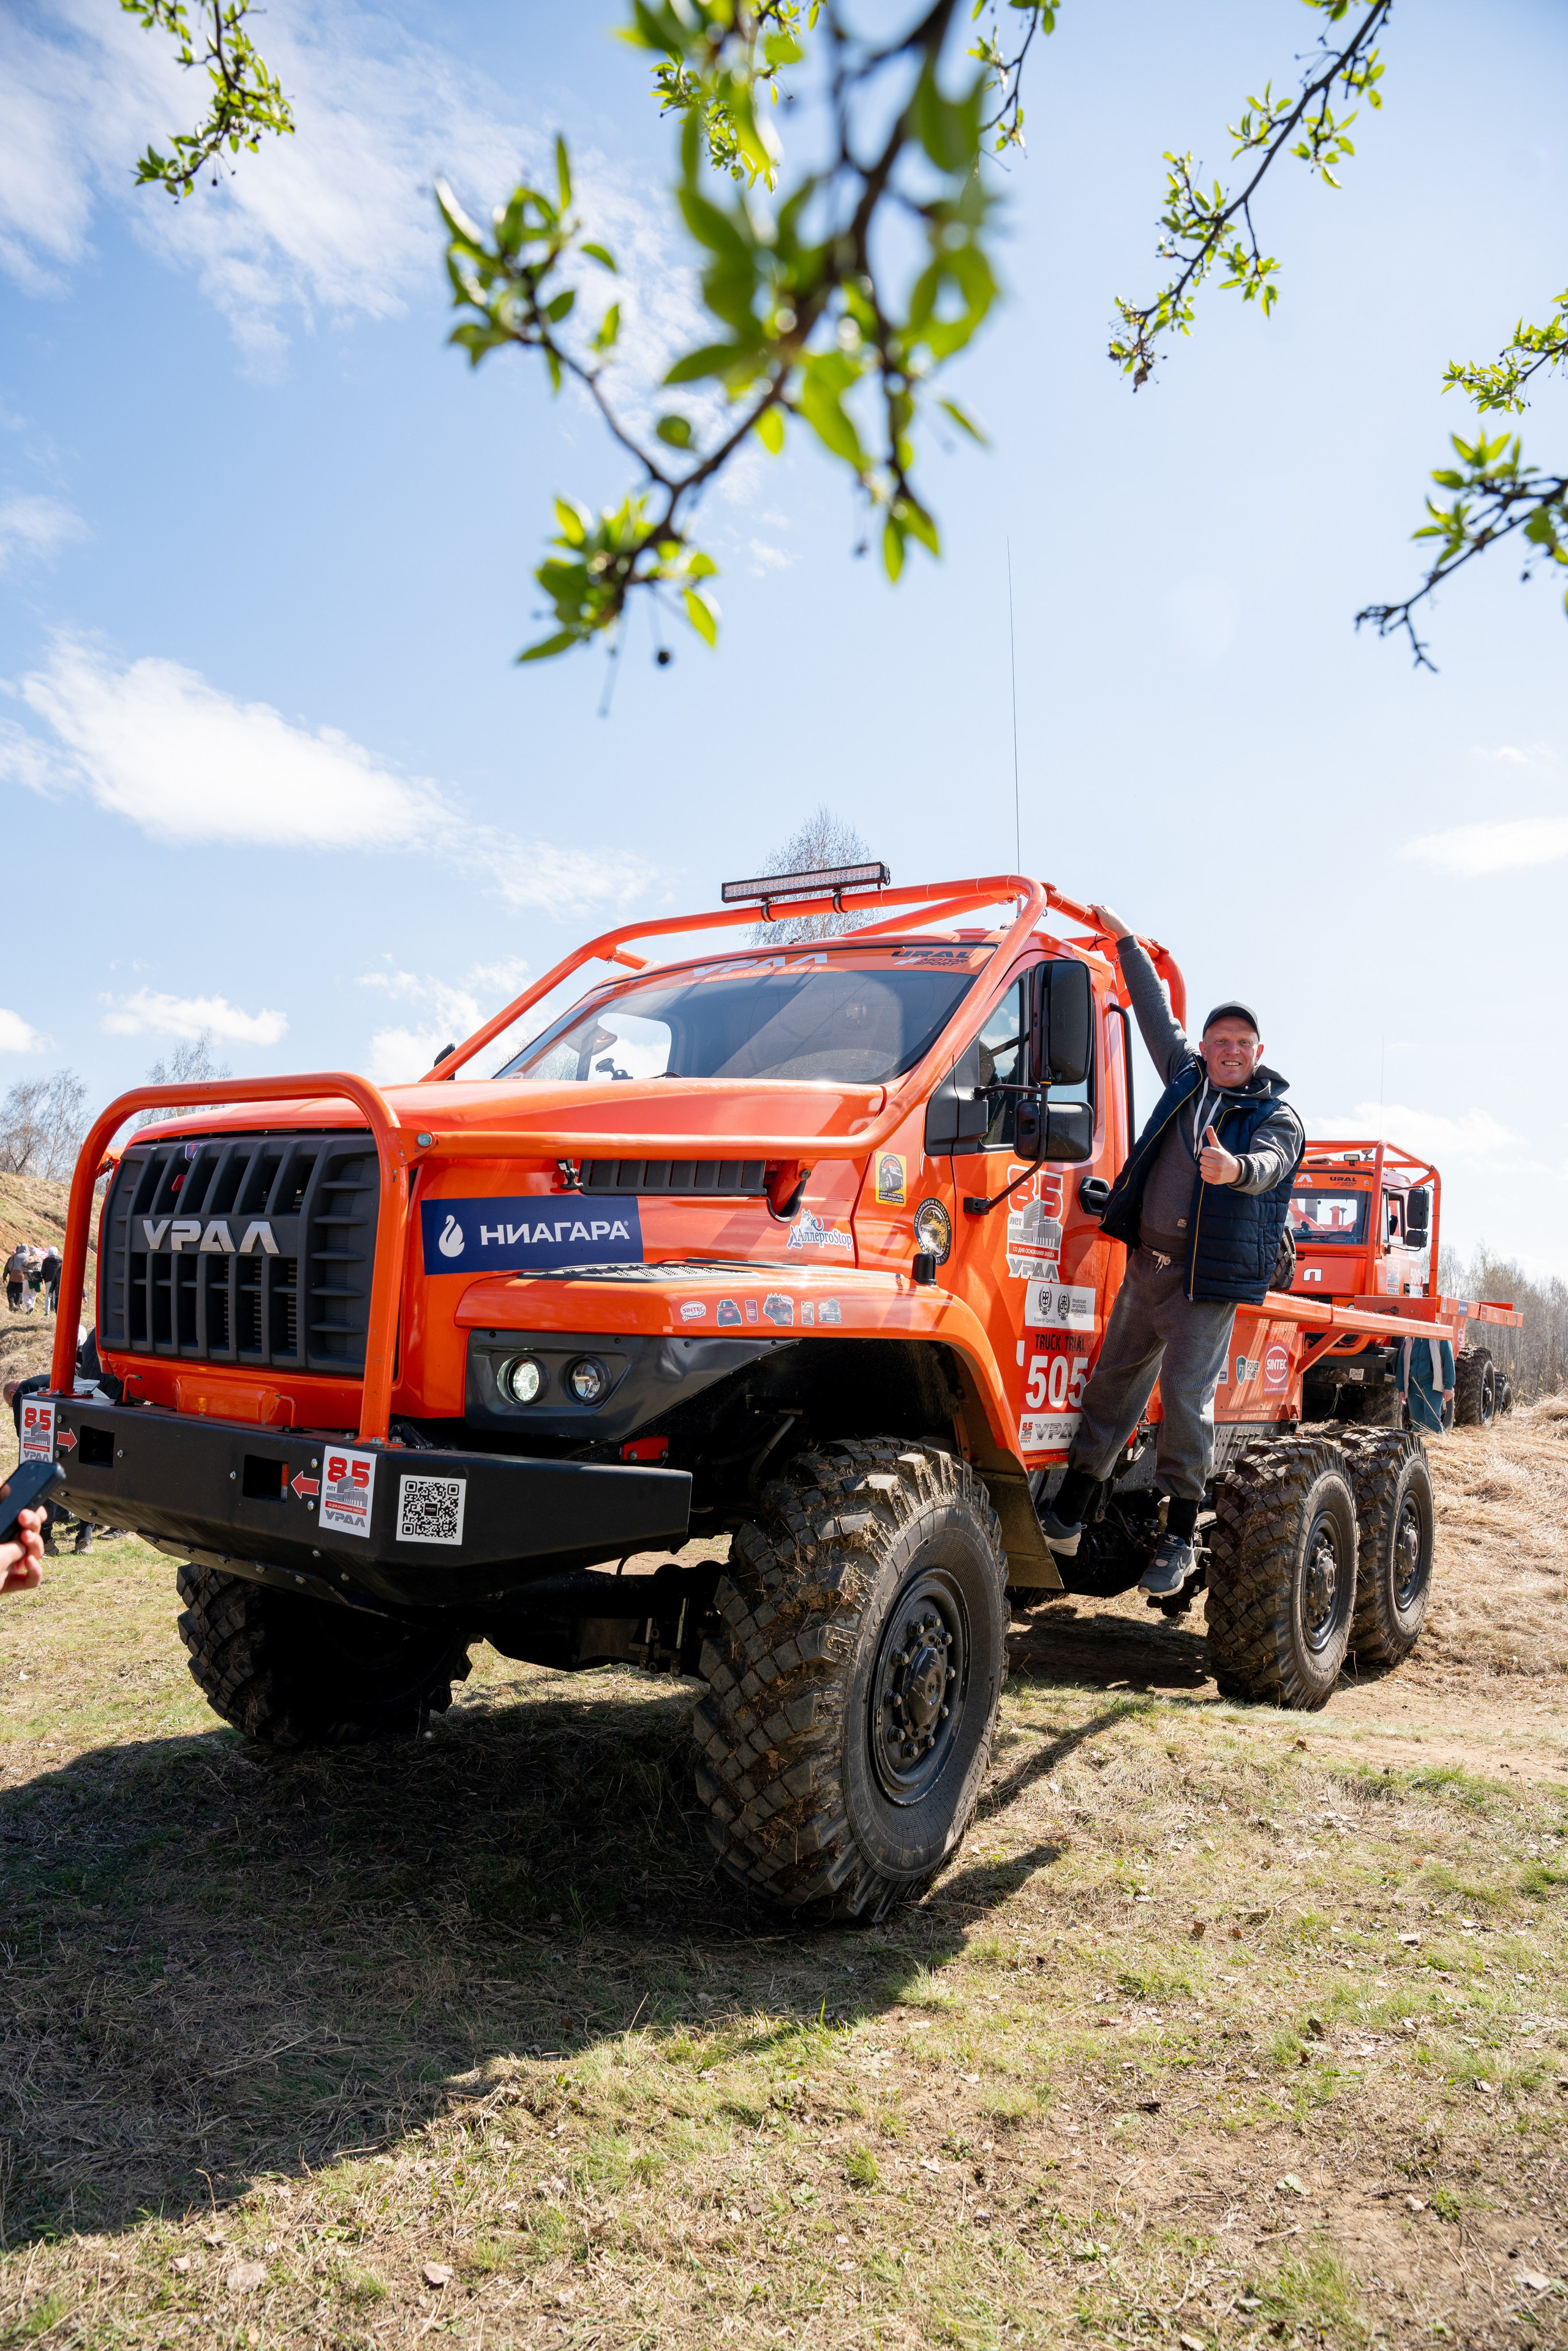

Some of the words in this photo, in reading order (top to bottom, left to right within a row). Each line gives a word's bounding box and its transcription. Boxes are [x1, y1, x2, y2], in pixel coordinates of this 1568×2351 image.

[692, 953, 827, 977] УРАЛ
[1009, 1168, 1062, 1218] 85
[1009, 1216, 1022, 1226] лет
[143, 1220, 280, 1254] УРАЛ
[798, 1228, 852, 1249] АллергоStop
[1008, 1259, 1058, 1279] УРАЛ
[1035, 1334, 1061, 1351] TRUCK
[1065, 1336, 1086, 1352] TRIAL
[1247, 1362, 1259, 1370] FORCE
[1267, 1359, 1287, 1370] SINTEC
[1025, 1355, 1088, 1408] 505
[24, 1407, 51, 1431] 85
[1022, 1422, 1033, 1431] 85
[1035, 1423, 1082, 1440] УРА
[23, 1451, 50, 1462] УРАЛ
[328, 1456, 371, 1489] 85
[325, 1510, 366, 1528] УРАЛ
